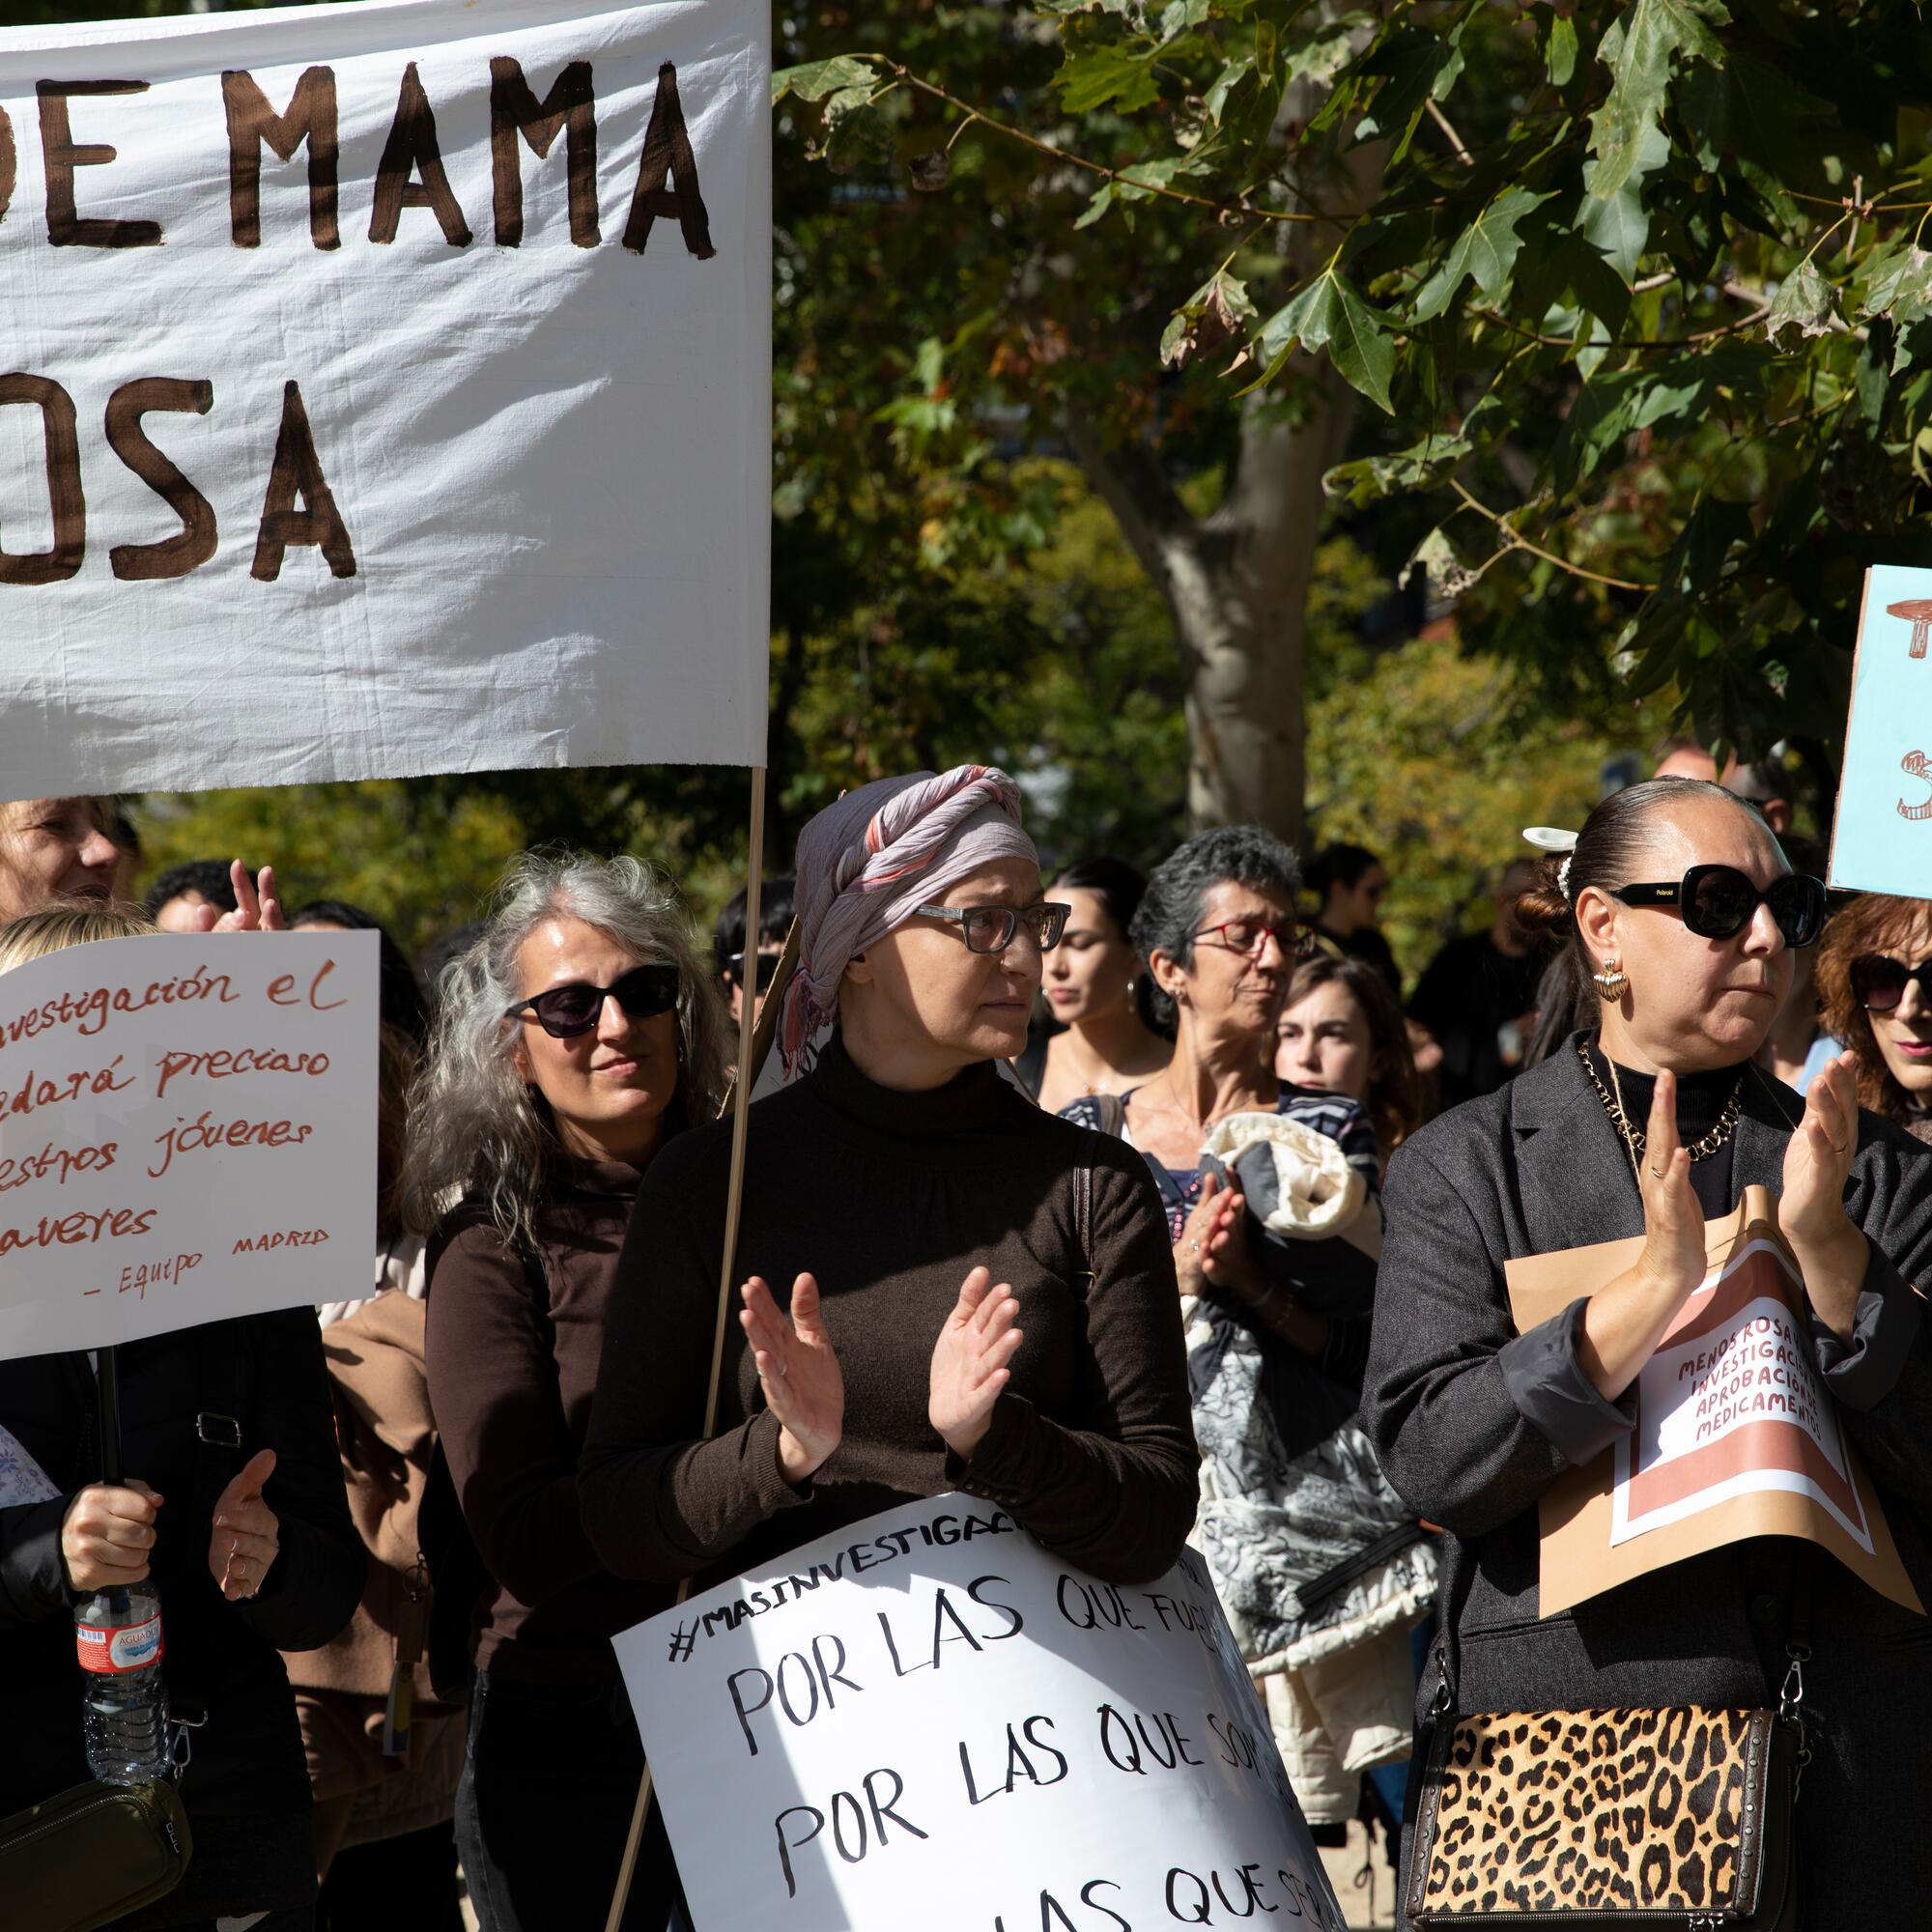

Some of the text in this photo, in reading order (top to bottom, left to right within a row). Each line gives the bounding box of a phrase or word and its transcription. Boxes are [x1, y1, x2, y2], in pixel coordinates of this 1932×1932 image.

[0, 56, 719, 261] E MAMA
[267, 958, 349, 1011] el
[1678, 1332, 1736, 1381] MENOS
[1743, 1316, 1792, 1344] ROSA
[1695, 1366, 1806, 1418] APROBACIÓN
[1695, 1392, 1823, 1442] MEDICAMENTOS
[727, 1634, 864, 1756] POR
[877, 1575, 1023, 1677] LAS
[1057, 1574, 1147, 1632] QUE
[775, 1768, 930, 1898] POR
[958, 1716, 1068, 1804] LAS
[1096, 1703, 1206, 1776] QUE
[1165, 1863, 1279, 1926] QUE
